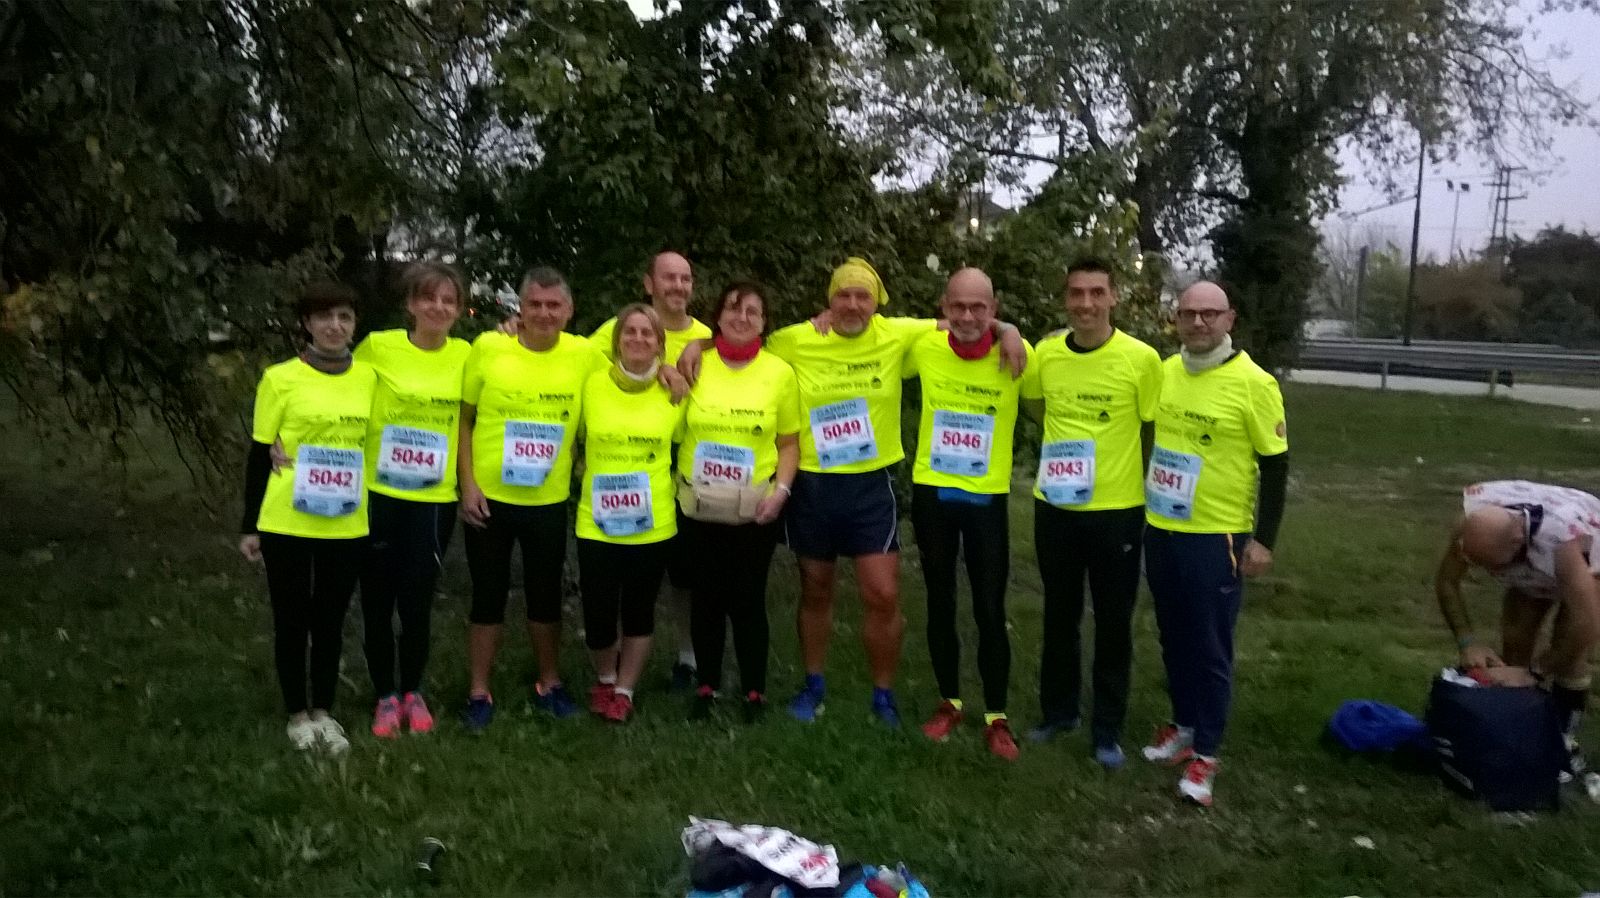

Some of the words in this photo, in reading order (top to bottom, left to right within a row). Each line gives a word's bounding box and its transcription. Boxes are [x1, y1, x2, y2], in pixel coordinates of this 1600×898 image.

[822, 419, 862, 441] 5049
[942, 431, 981, 448] 5046
[391, 446, 435, 467] 5044
[514, 440, 554, 459] 5039
[308, 469, 353, 486] 5042
[703, 461, 742, 481] 5045
[1047, 461, 1083, 476] 5043
[1153, 468, 1183, 490] 5041
[601, 493, 641, 510] 5040
